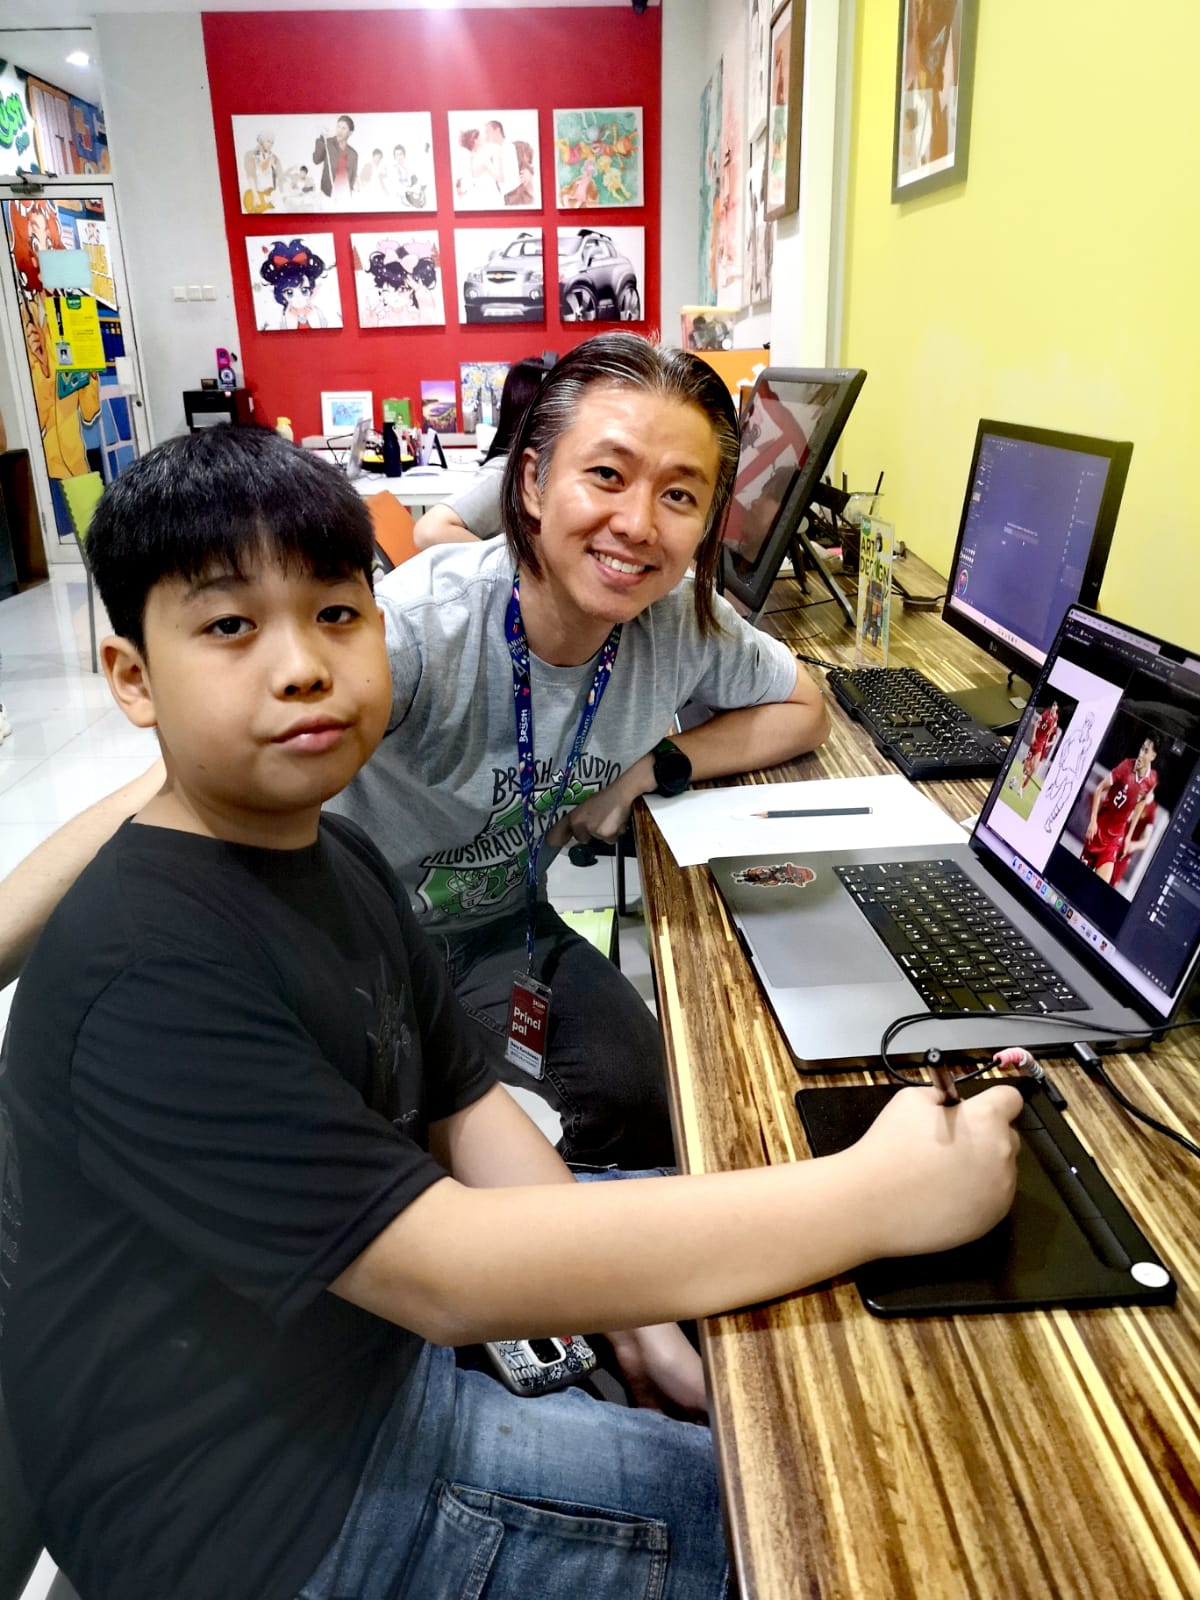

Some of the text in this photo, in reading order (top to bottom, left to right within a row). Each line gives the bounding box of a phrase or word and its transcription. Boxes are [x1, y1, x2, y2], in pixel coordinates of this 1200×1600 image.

[861, 536, 875, 557] ART
[492, 757, 553, 806] BRSH
[1113, 790, 1127, 808] 27
[512, 1021, 528, 1036] pal
[514, 1006, 541, 1031] Princi
